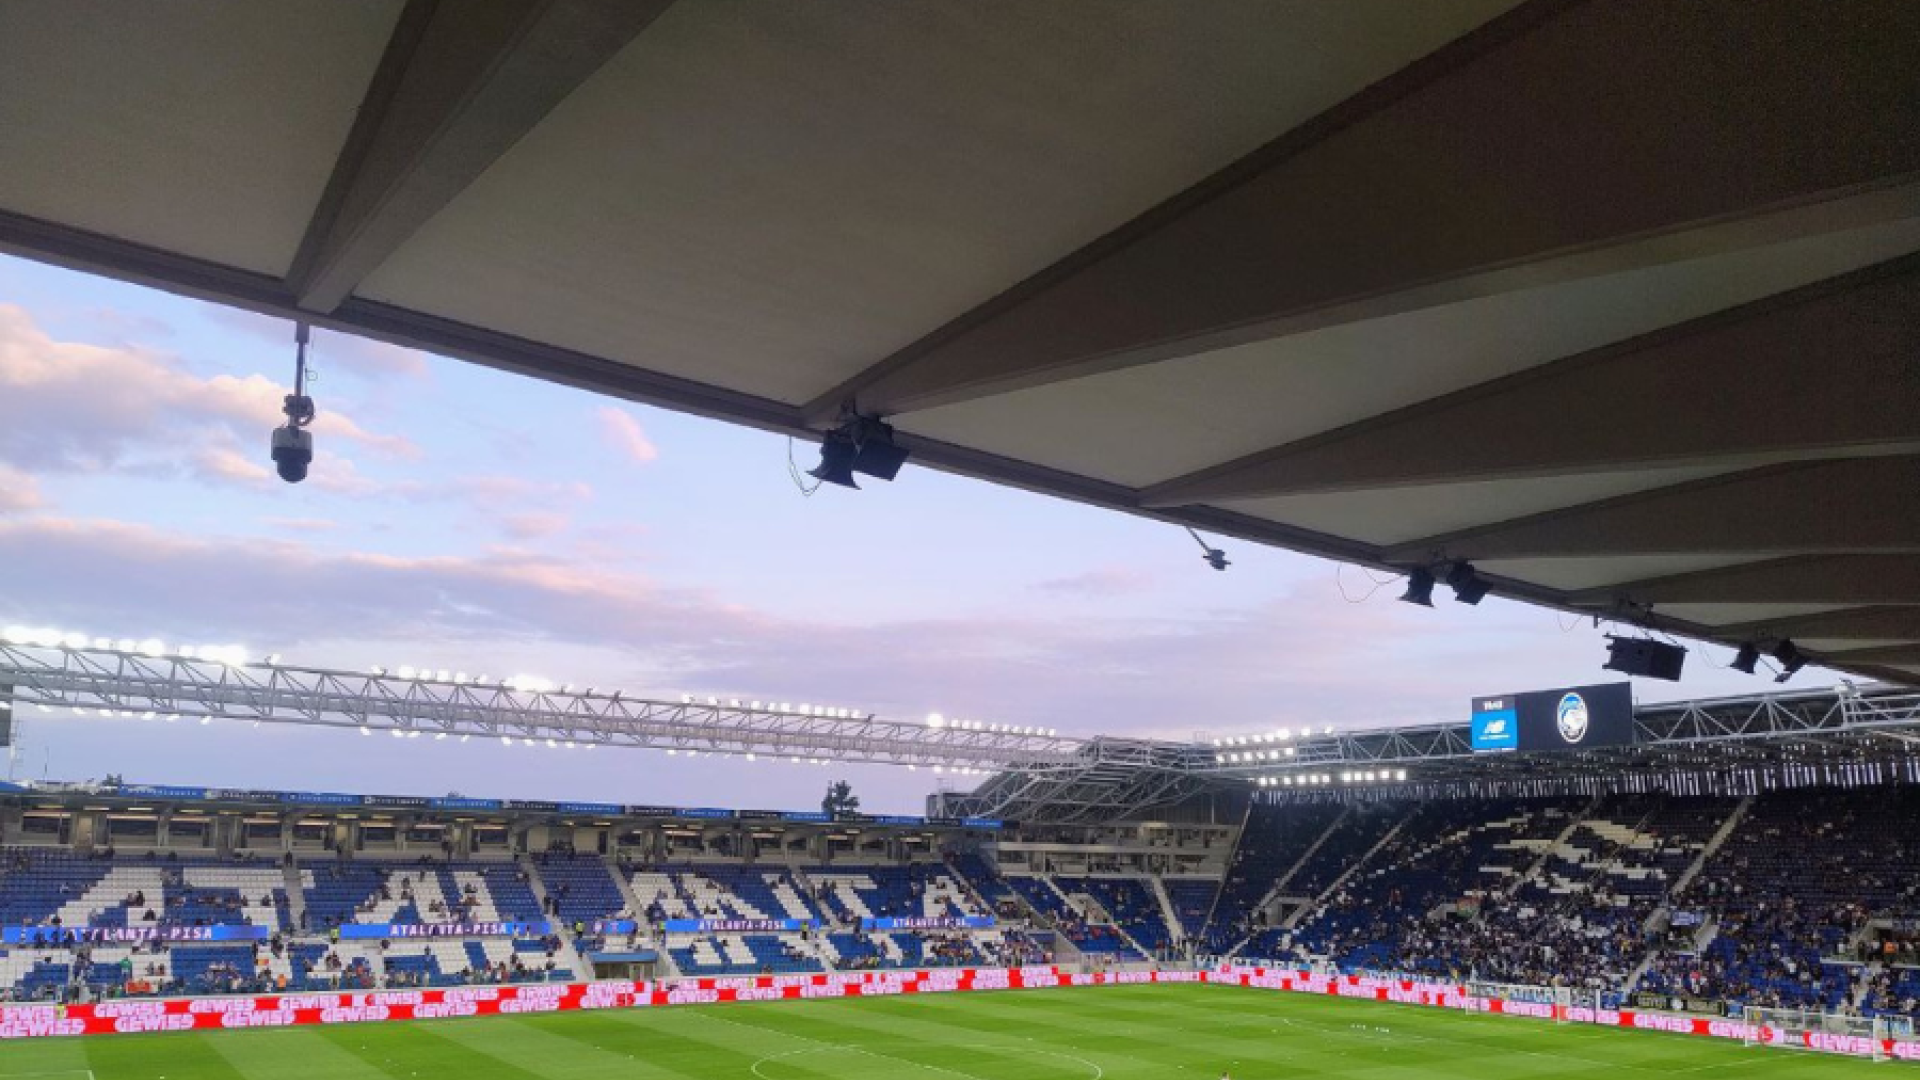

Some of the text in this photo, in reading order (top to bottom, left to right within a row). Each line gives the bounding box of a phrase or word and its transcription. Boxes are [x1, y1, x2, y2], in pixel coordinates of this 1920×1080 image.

[221, 1009, 295, 1027] GEWISS
[320, 1005, 390, 1022] GEWISS
[414, 1001, 477, 1018] GEWISS
[0, 1018, 85, 1037] GEWISS
[114, 1013, 195, 1032] GEWISS
[1634, 1013, 1693, 1034] GEWISS
